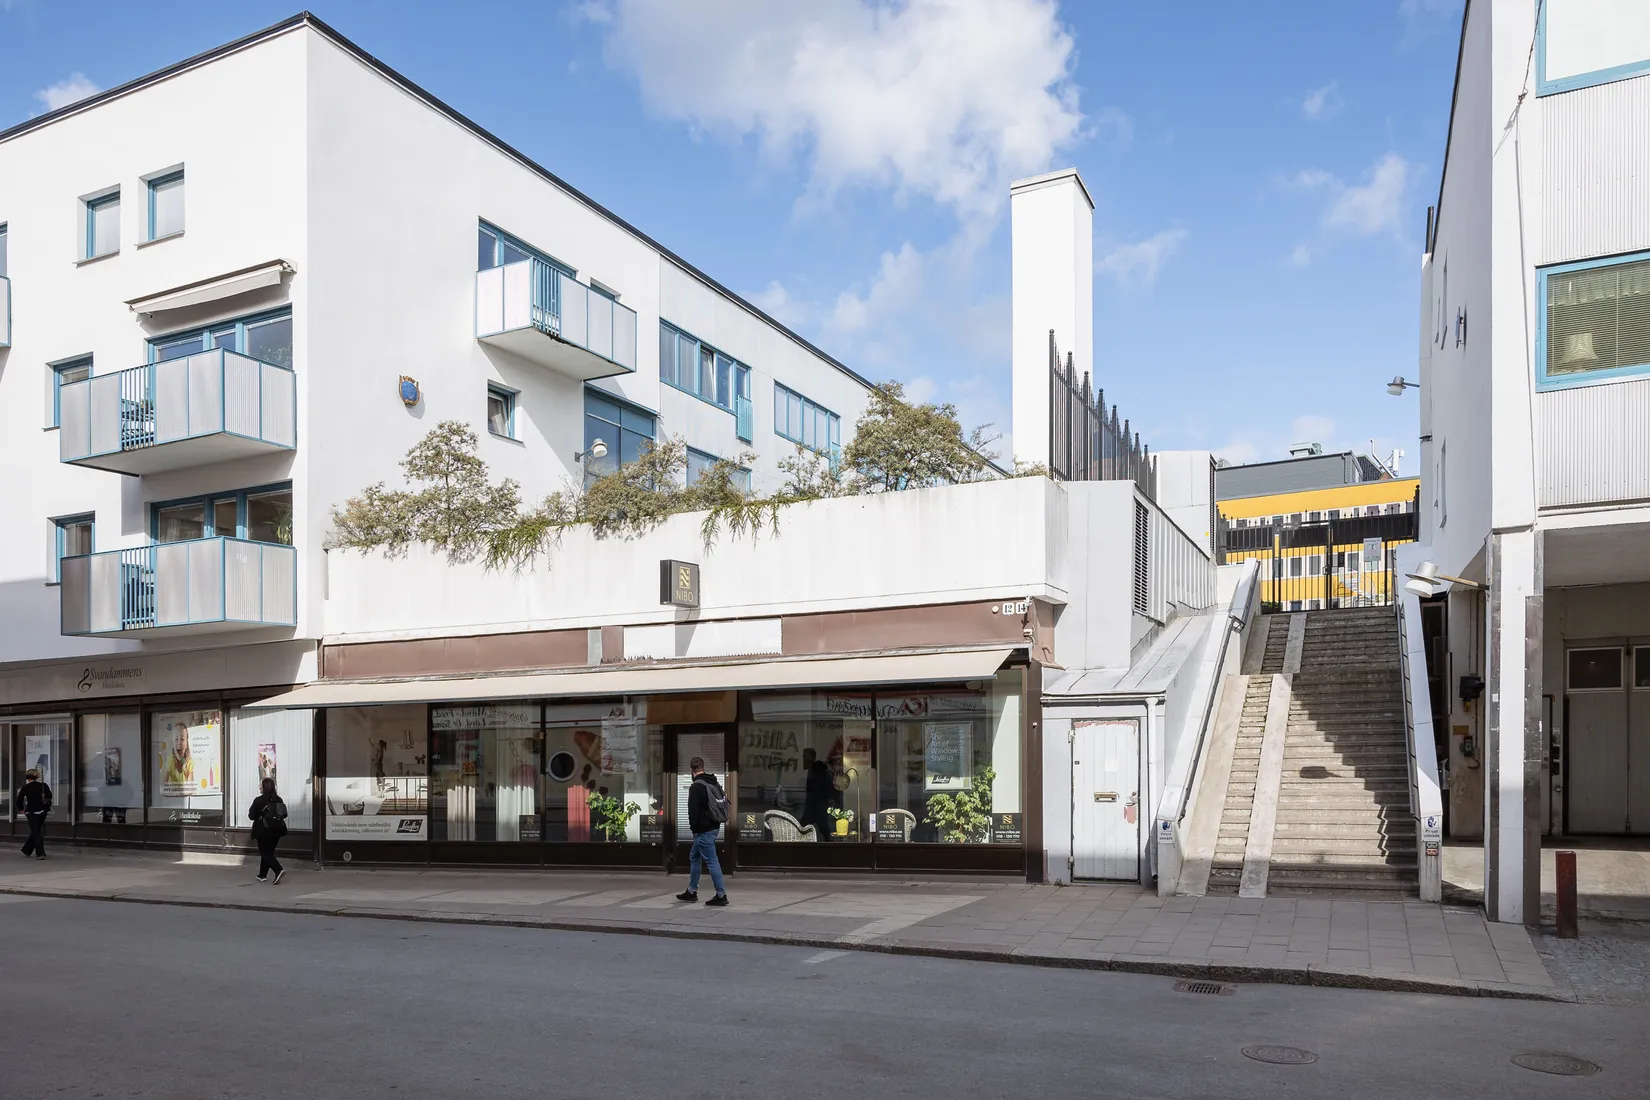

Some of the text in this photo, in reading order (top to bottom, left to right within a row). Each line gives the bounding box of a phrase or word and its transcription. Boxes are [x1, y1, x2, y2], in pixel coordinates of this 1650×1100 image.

[676, 590, 694, 602] NIBO
[1004, 604, 1013, 613] 12
[1017, 603, 1026, 613] 14
[90, 666, 142, 680] Svandammens
